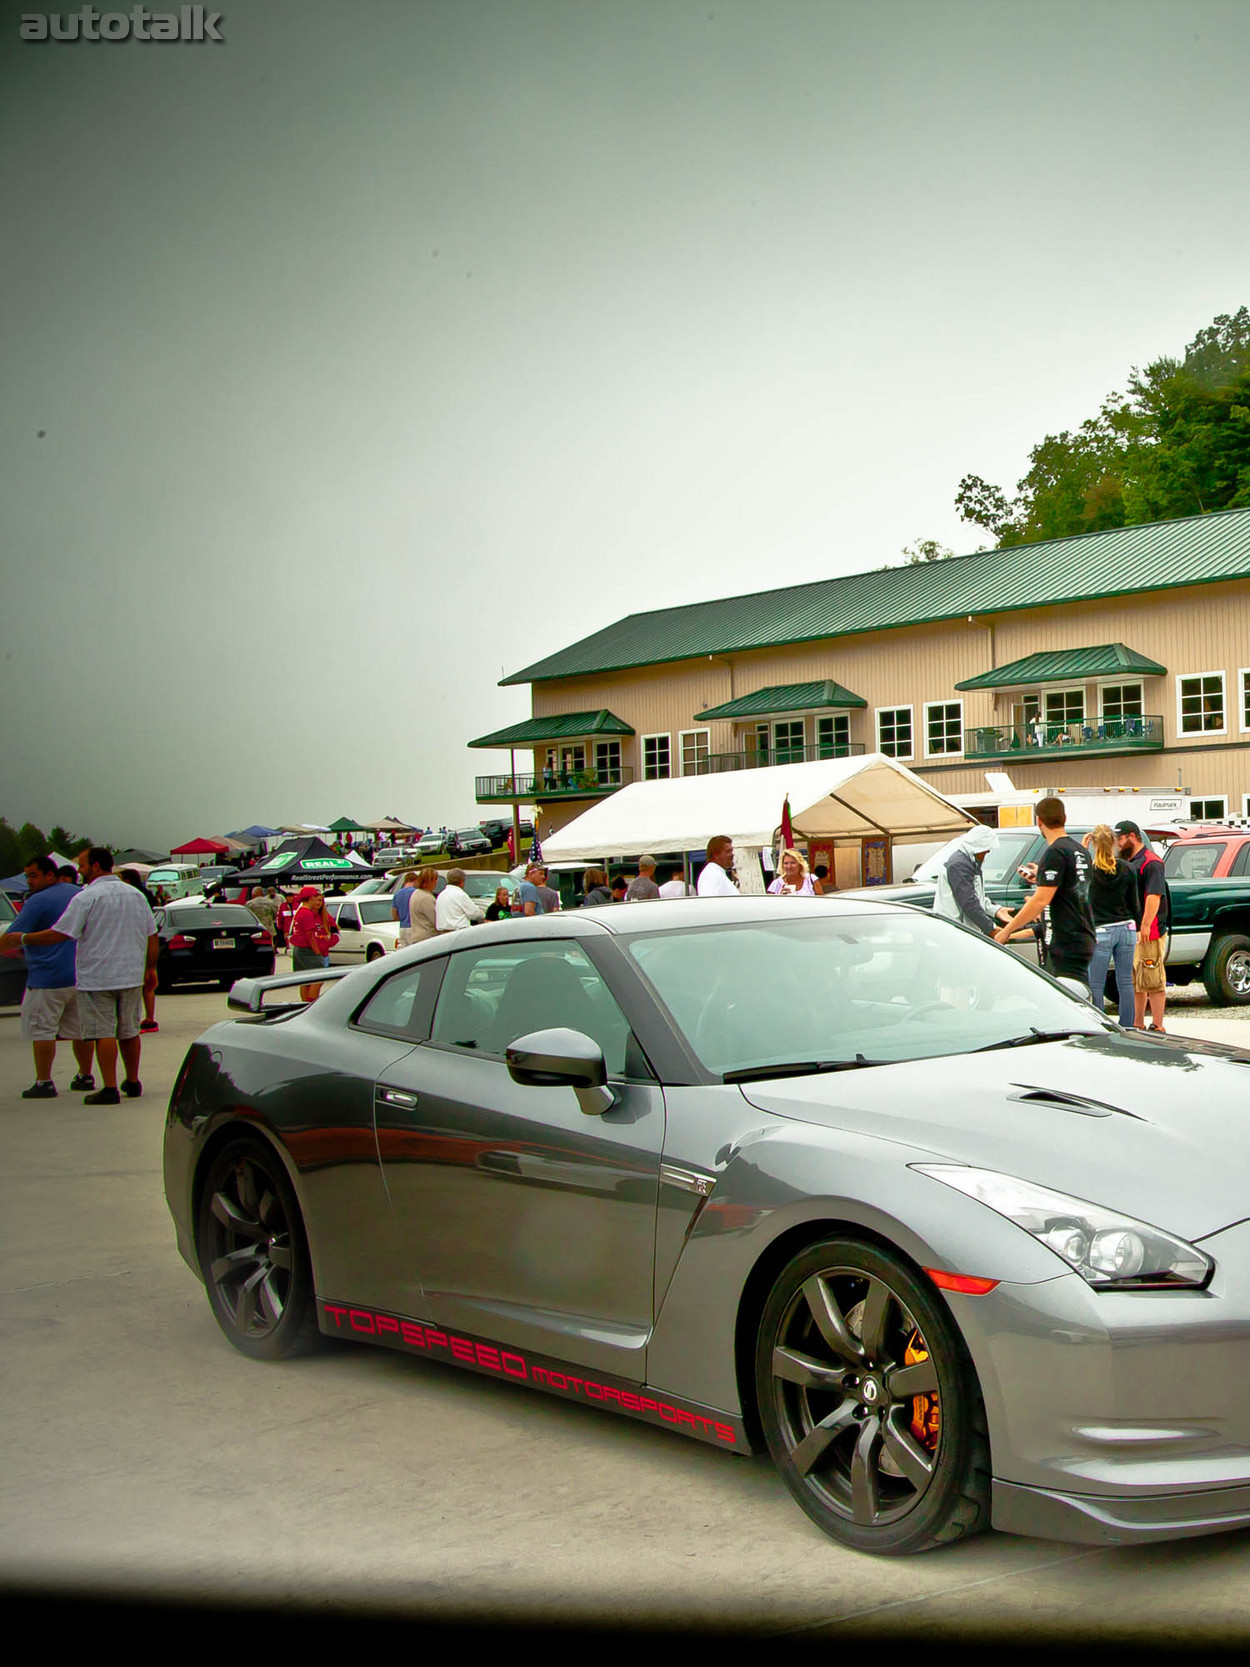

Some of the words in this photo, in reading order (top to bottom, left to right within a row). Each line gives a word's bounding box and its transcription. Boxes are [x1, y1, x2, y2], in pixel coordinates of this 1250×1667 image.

[305, 860, 337, 868] REAL
[291, 873, 374, 882] RealStreetPerformance.com
[323, 1304, 528, 1380] TOPSPEED
[531, 1366, 737, 1444] MOTORSPORTS
